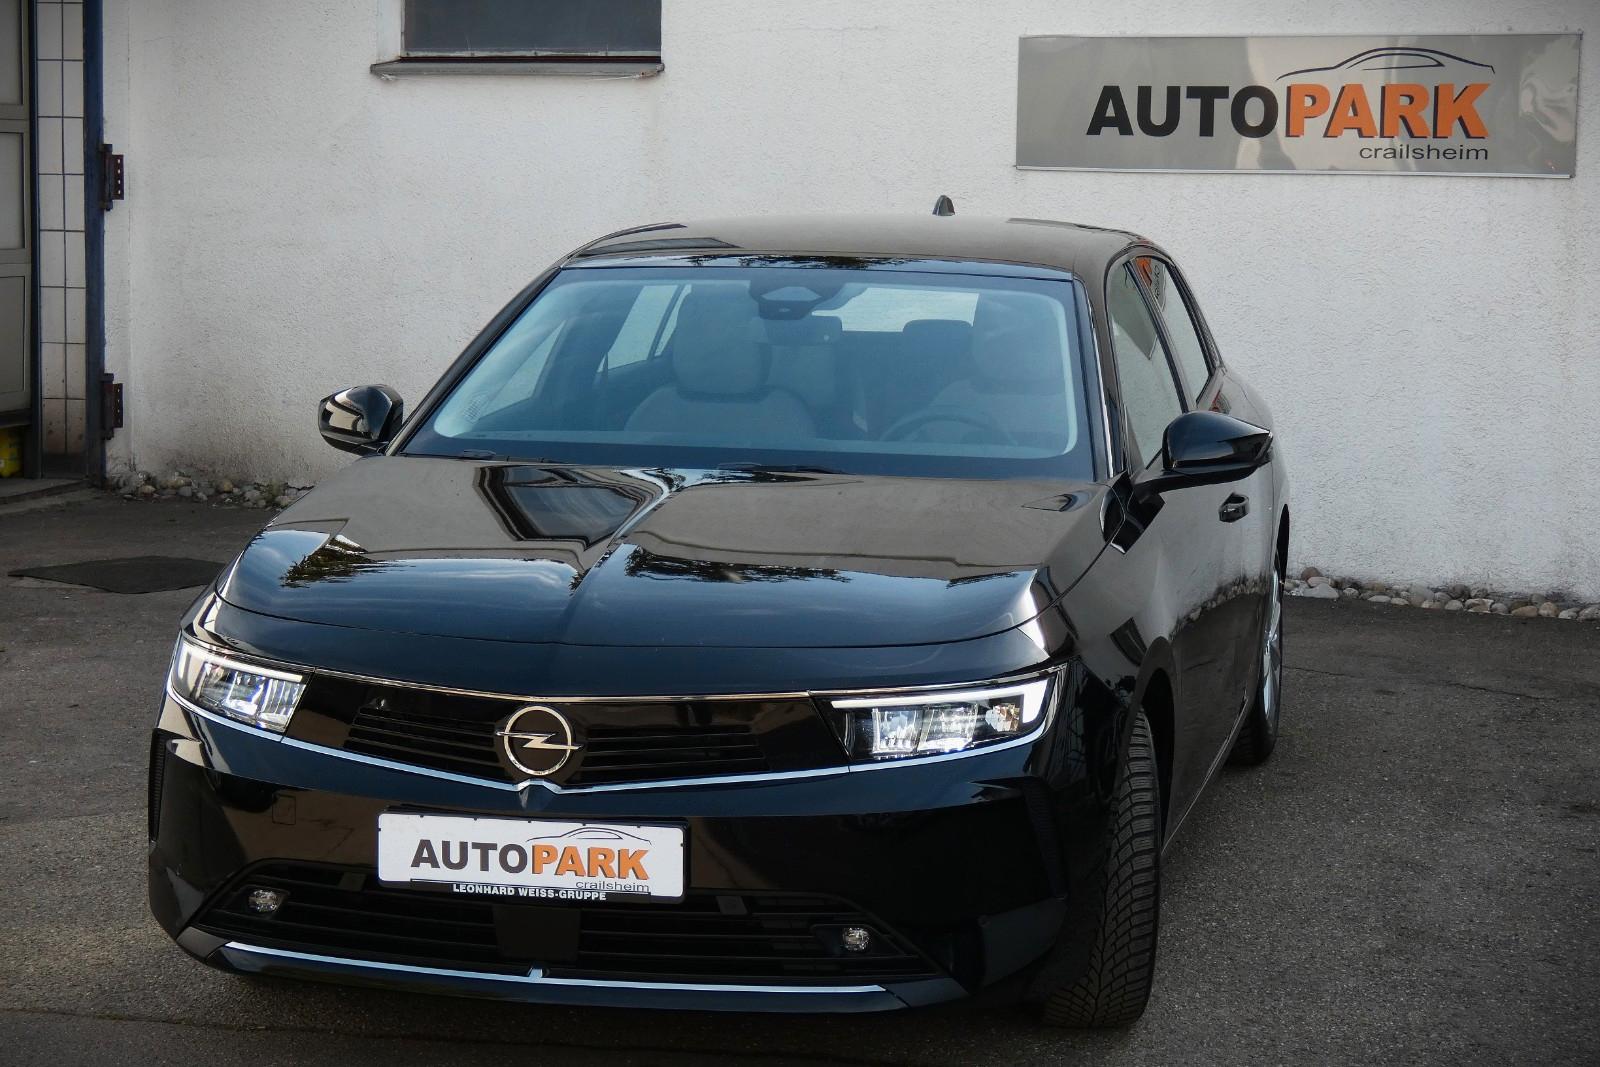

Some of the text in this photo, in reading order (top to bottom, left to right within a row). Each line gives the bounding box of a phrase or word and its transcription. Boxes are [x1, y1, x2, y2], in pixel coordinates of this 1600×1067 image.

[1359, 144, 1489, 161] crailsheim
[453, 884, 607, 900] LEONHARD WEISS-GRUPPE
[575, 880, 650, 892] crailsheim
